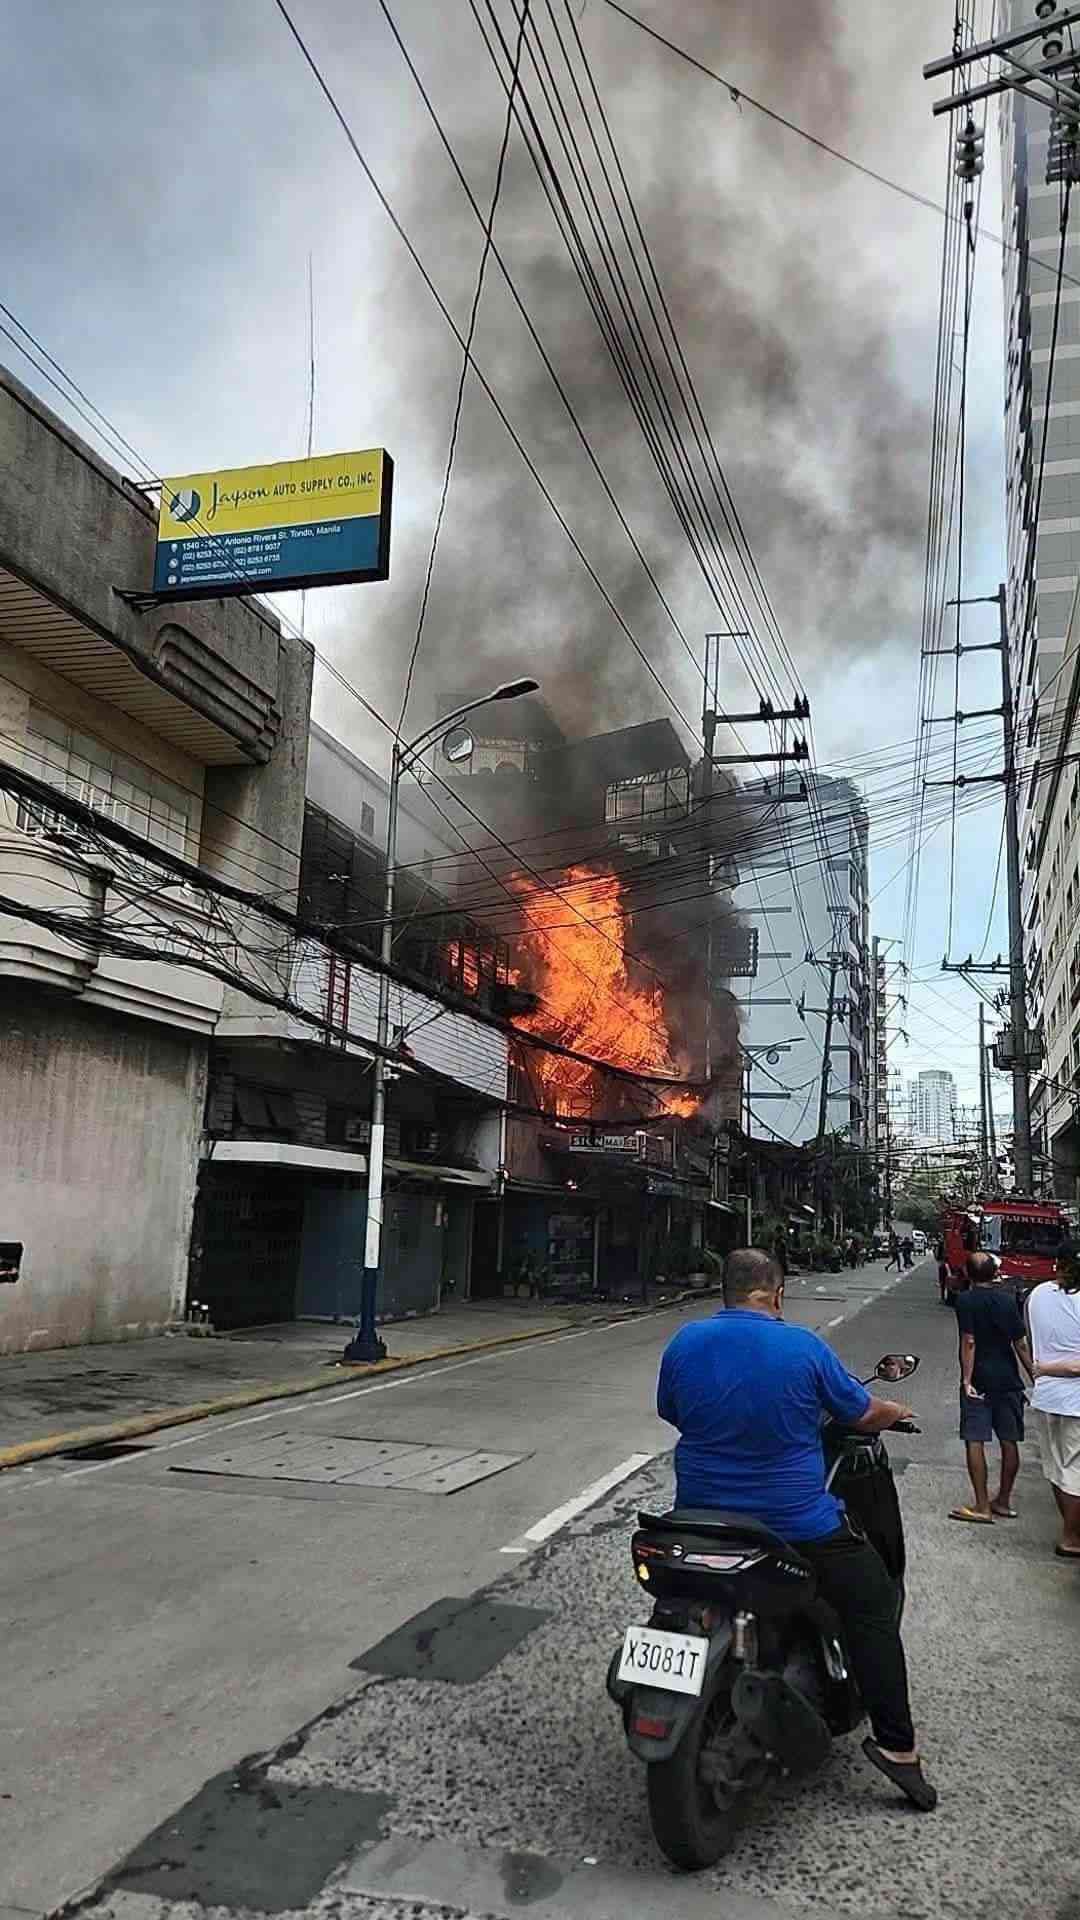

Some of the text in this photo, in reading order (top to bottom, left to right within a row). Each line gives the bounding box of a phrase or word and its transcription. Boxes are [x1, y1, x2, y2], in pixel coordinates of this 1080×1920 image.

[206, 482, 270, 521] Jayson
[273, 482, 296, 497] AUTO
[301, 478, 333, 493] SUPPLY
[357, 471, 376, 485] INC.
[225, 535, 252, 546] Antonio
[253, 533, 277, 543] Rivera
[291, 526, 315, 537] Tondo,
[316, 524, 341, 534] Manila
[625, 1640, 699, 1680] X3081T
